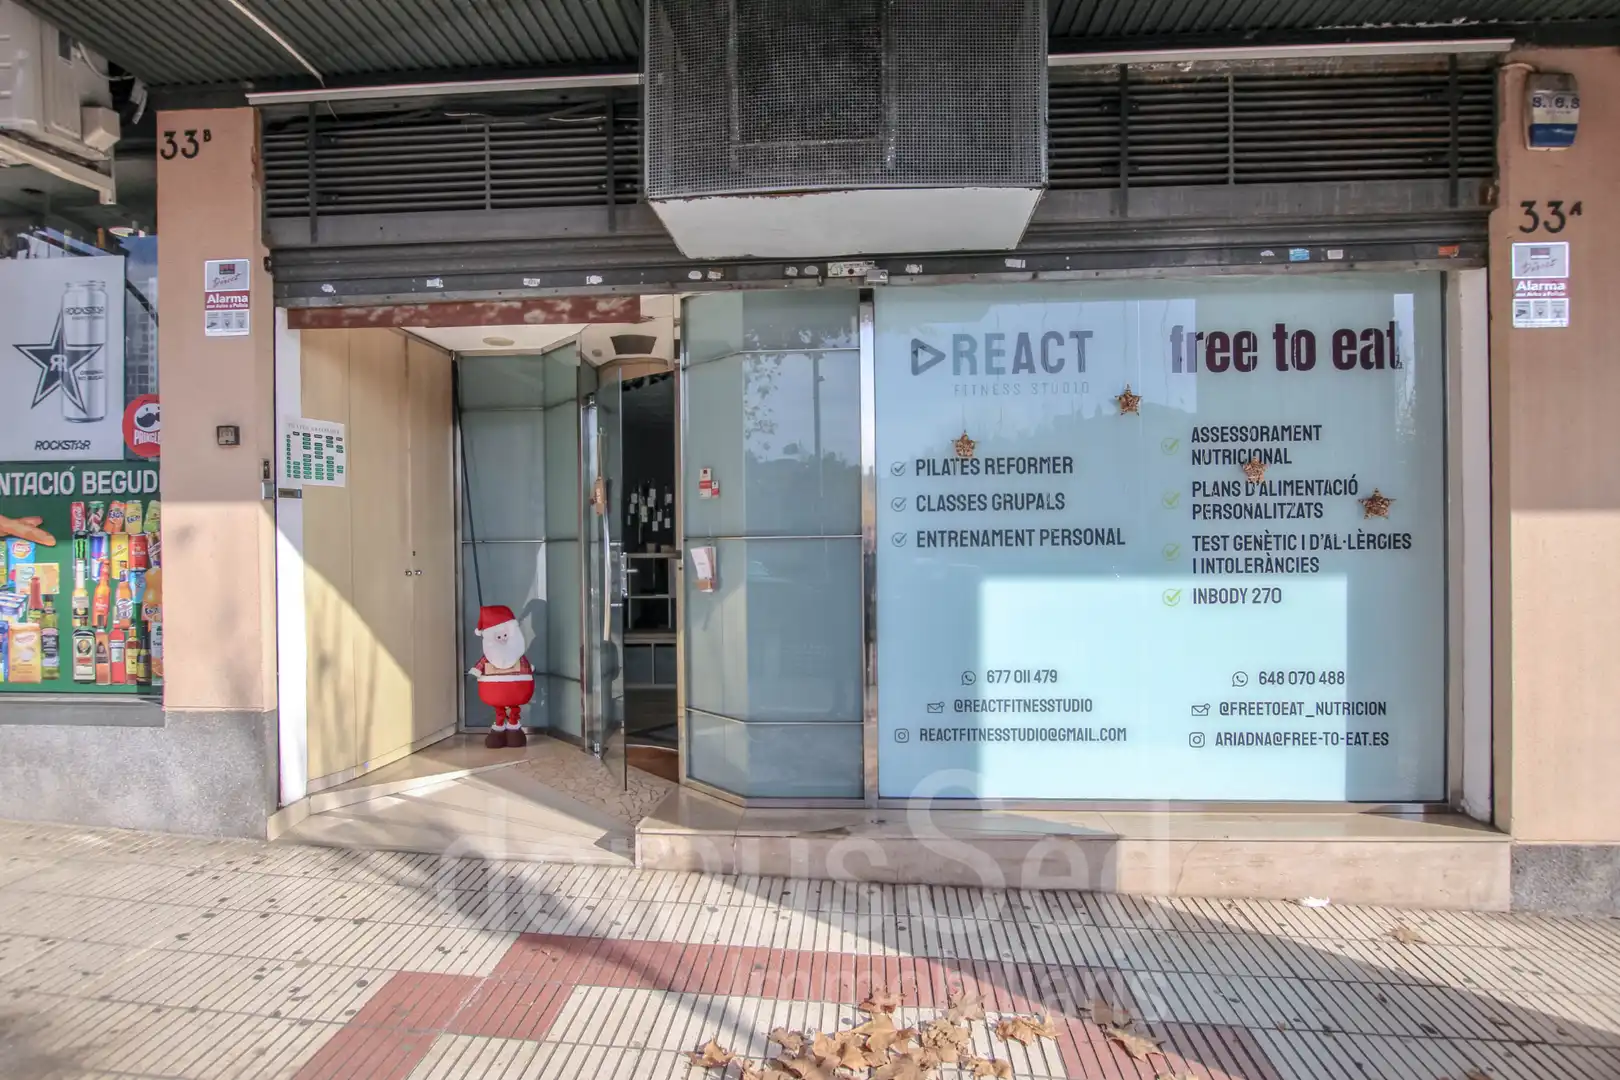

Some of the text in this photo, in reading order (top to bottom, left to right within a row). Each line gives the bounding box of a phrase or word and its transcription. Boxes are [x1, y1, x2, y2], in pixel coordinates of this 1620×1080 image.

[1516, 280, 1566, 291] Alarma
[207, 293, 248, 304] Alarma
[952, 330, 1093, 376] REACT
[1170, 321, 1403, 373] free to eat
[954, 382, 1090, 397] FITNESS STUDIO
[1191, 425, 1322, 443] ASSESSORAMENT
[34, 440, 91, 451] ROCKSTAR
[915, 456, 1074, 476] PILATES REFORMER
[1191, 448, 1292, 466] NUTRICIONAL
[82, 469, 160, 495] BEGUD
[1192, 474, 1358, 498] PLANS D'ALIMENTACIÓ
[916, 492, 1065, 512] CLASSES GRUPALS
[1192, 502, 1323, 520] PERSONALITZATS
[916, 527, 1125, 548] ENTRENAMENT PERSONAL
[1192, 535, 1229, 552] TEST
[1233, 530, 1297, 552] GENÈTIC
[1193, 552, 1320, 574] I INTOLERÀNCIES
[1193, 587, 1282, 605] INBODY 270
[986, 669, 1058, 684] 677 011 479
[1258, 671, 1345, 685] 648 070 488
[953, 698, 1093, 713] @REACTFITNESSTUDIO
[1219, 701, 1387, 717] @FREETOEAT_NUTRICION
[920, 727, 1127, 742] REACTFITNESSTUDIO@GMAIL.COM
[1215, 731, 1390, 747] ARIADNA@FREE-TO-EAT.ES
